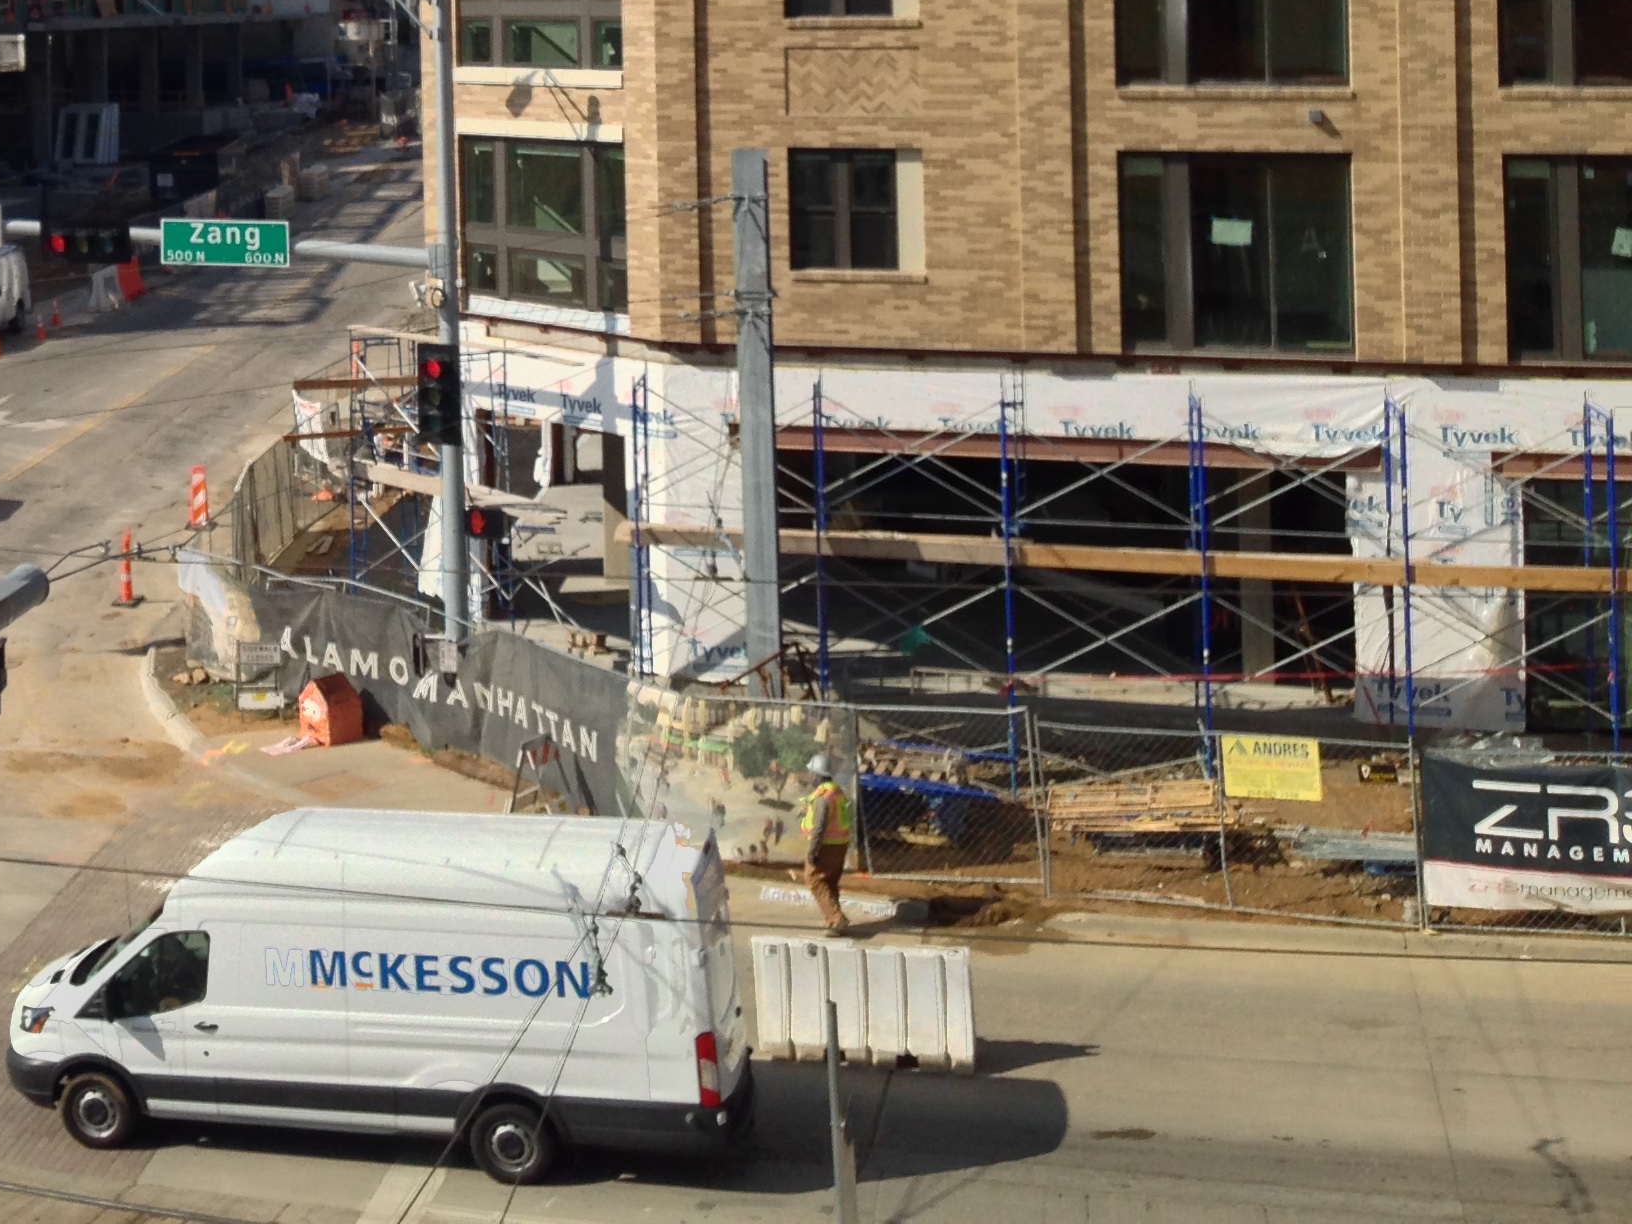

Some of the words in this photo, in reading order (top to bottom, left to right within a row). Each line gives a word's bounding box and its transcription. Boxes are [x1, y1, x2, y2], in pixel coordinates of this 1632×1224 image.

[190, 222, 261, 251] Zang
[166, 249, 193, 262] 500
[195, 250, 205, 263] N
[244, 251, 272, 264] 600
[274, 252, 284, 265] N
[560, 392, 603, 414] Tyvek
[1440, 425, 1518, 447] Tyvek
[688, 638, 748, 662] Tyve
[280, 626, 409, 685] ALAMO
[412, 669, 599, 764] MANHATTAN
[1253, 741, 1310, 759] ANDRES
[1472, 779, 1632, 844] ZR
[309, 949, 591, 999] McKESSON
